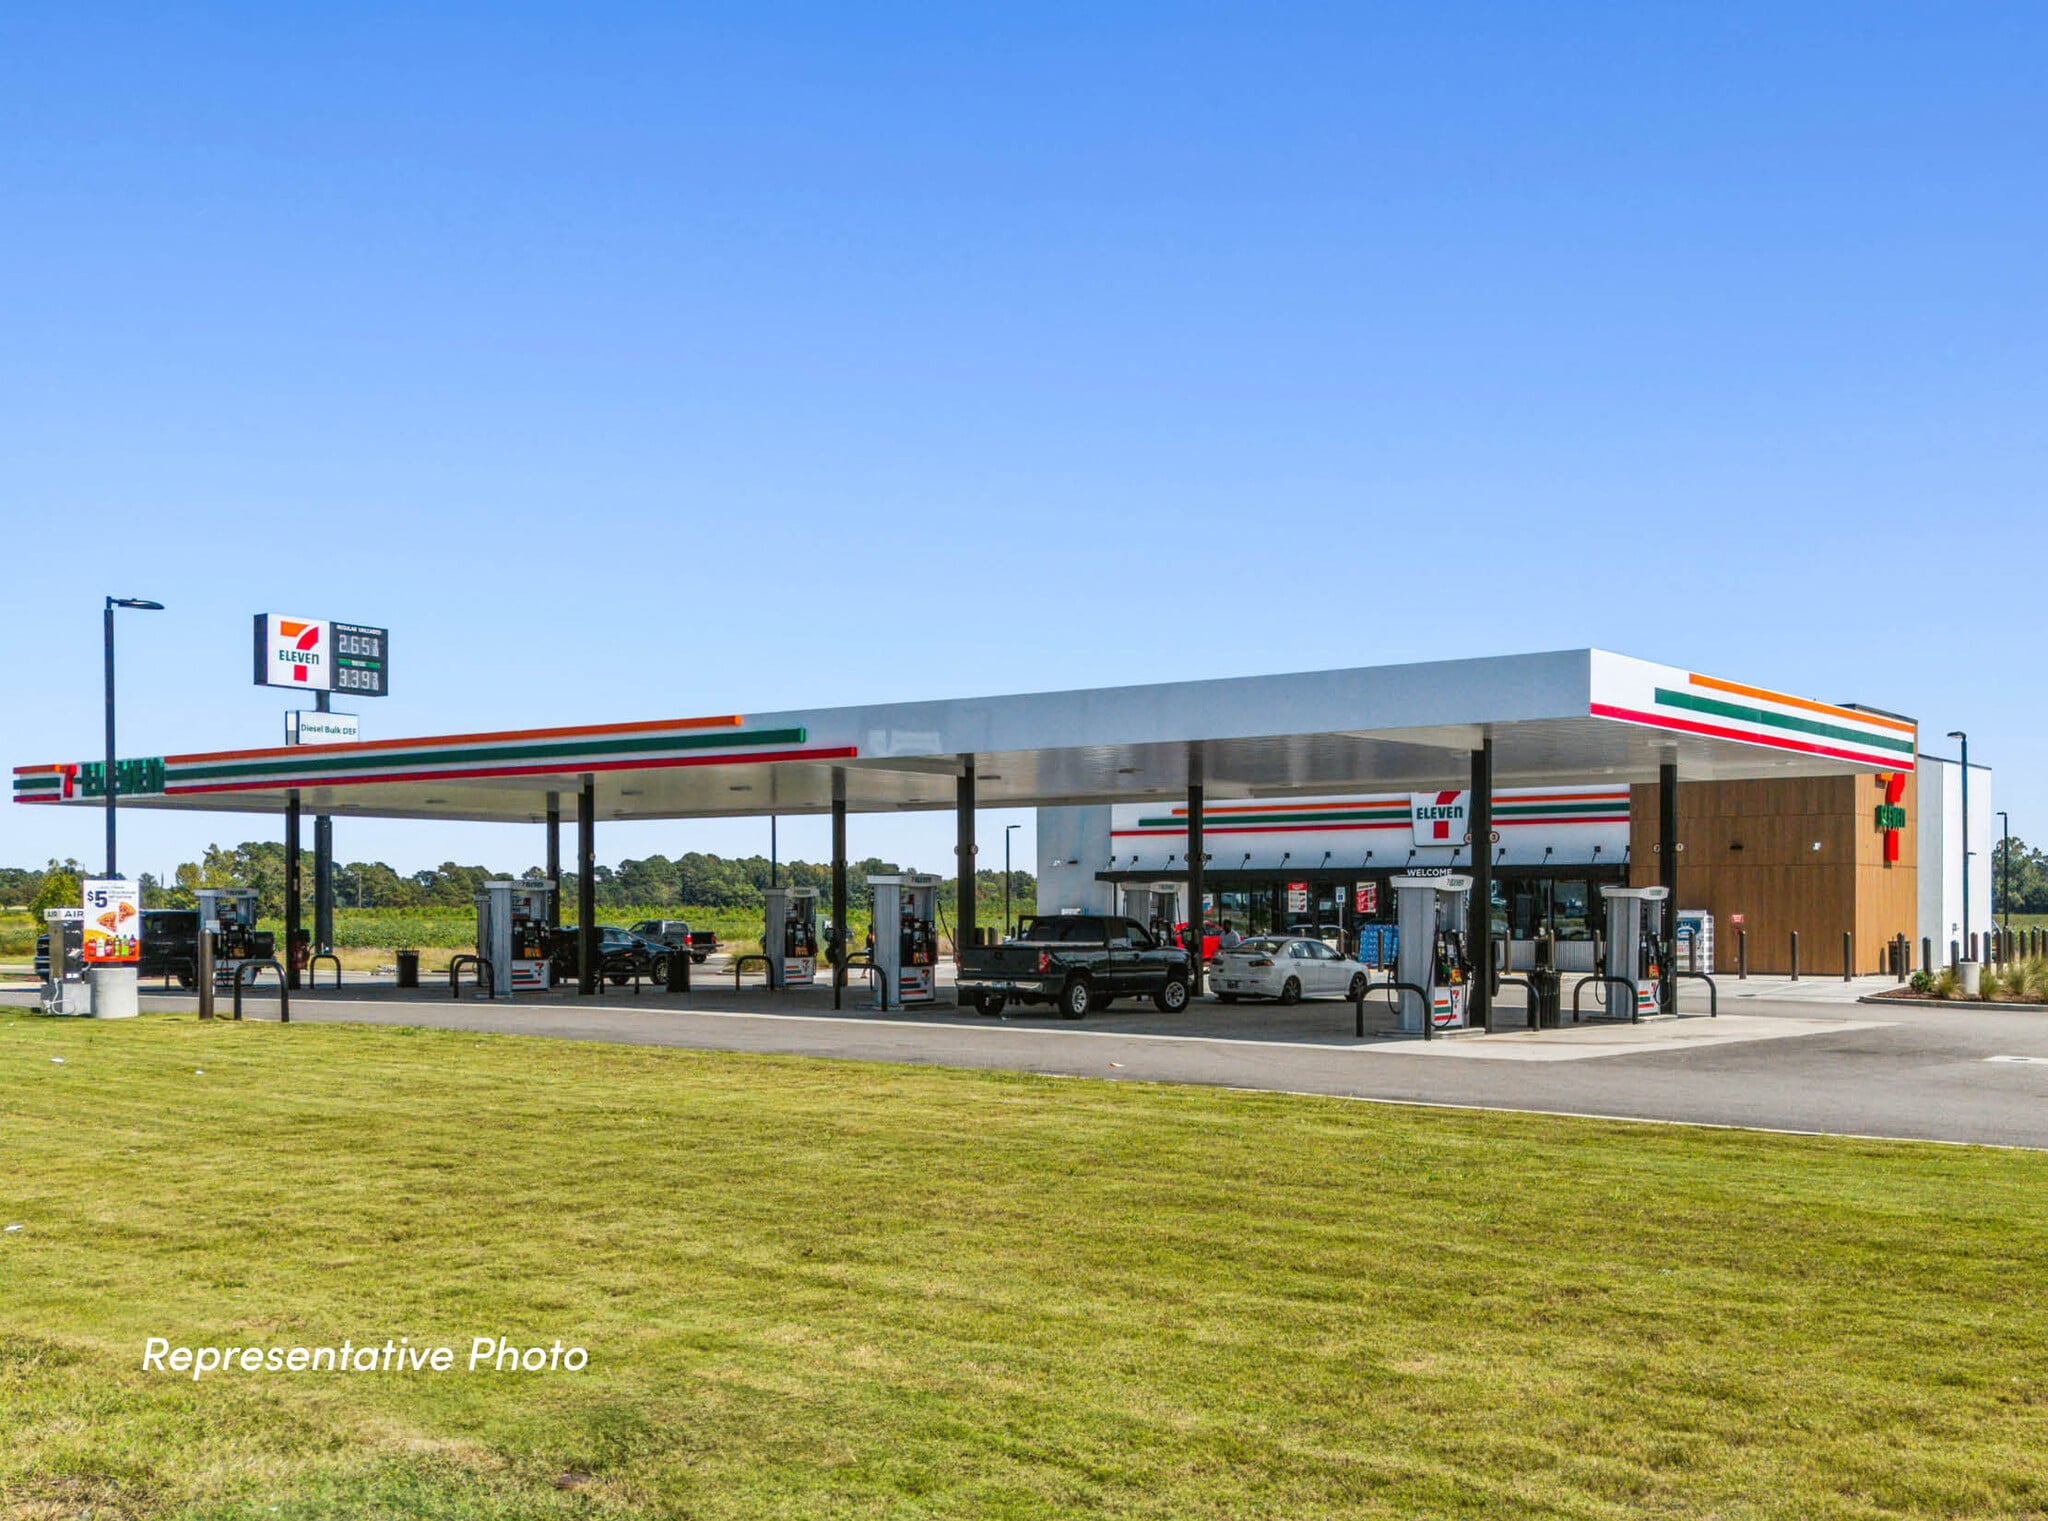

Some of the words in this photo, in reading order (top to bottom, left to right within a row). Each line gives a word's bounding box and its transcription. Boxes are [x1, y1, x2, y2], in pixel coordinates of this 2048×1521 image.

[300, 724, 323, 733] Diesel
[325, 726, 341, 734] Bulk
[342, 727, 357, 735] DEF
[1407, 868, 1453, 878] WELCOME
[87, 890, 108, 909] $5
[64, 910, 84, 918] AIR
